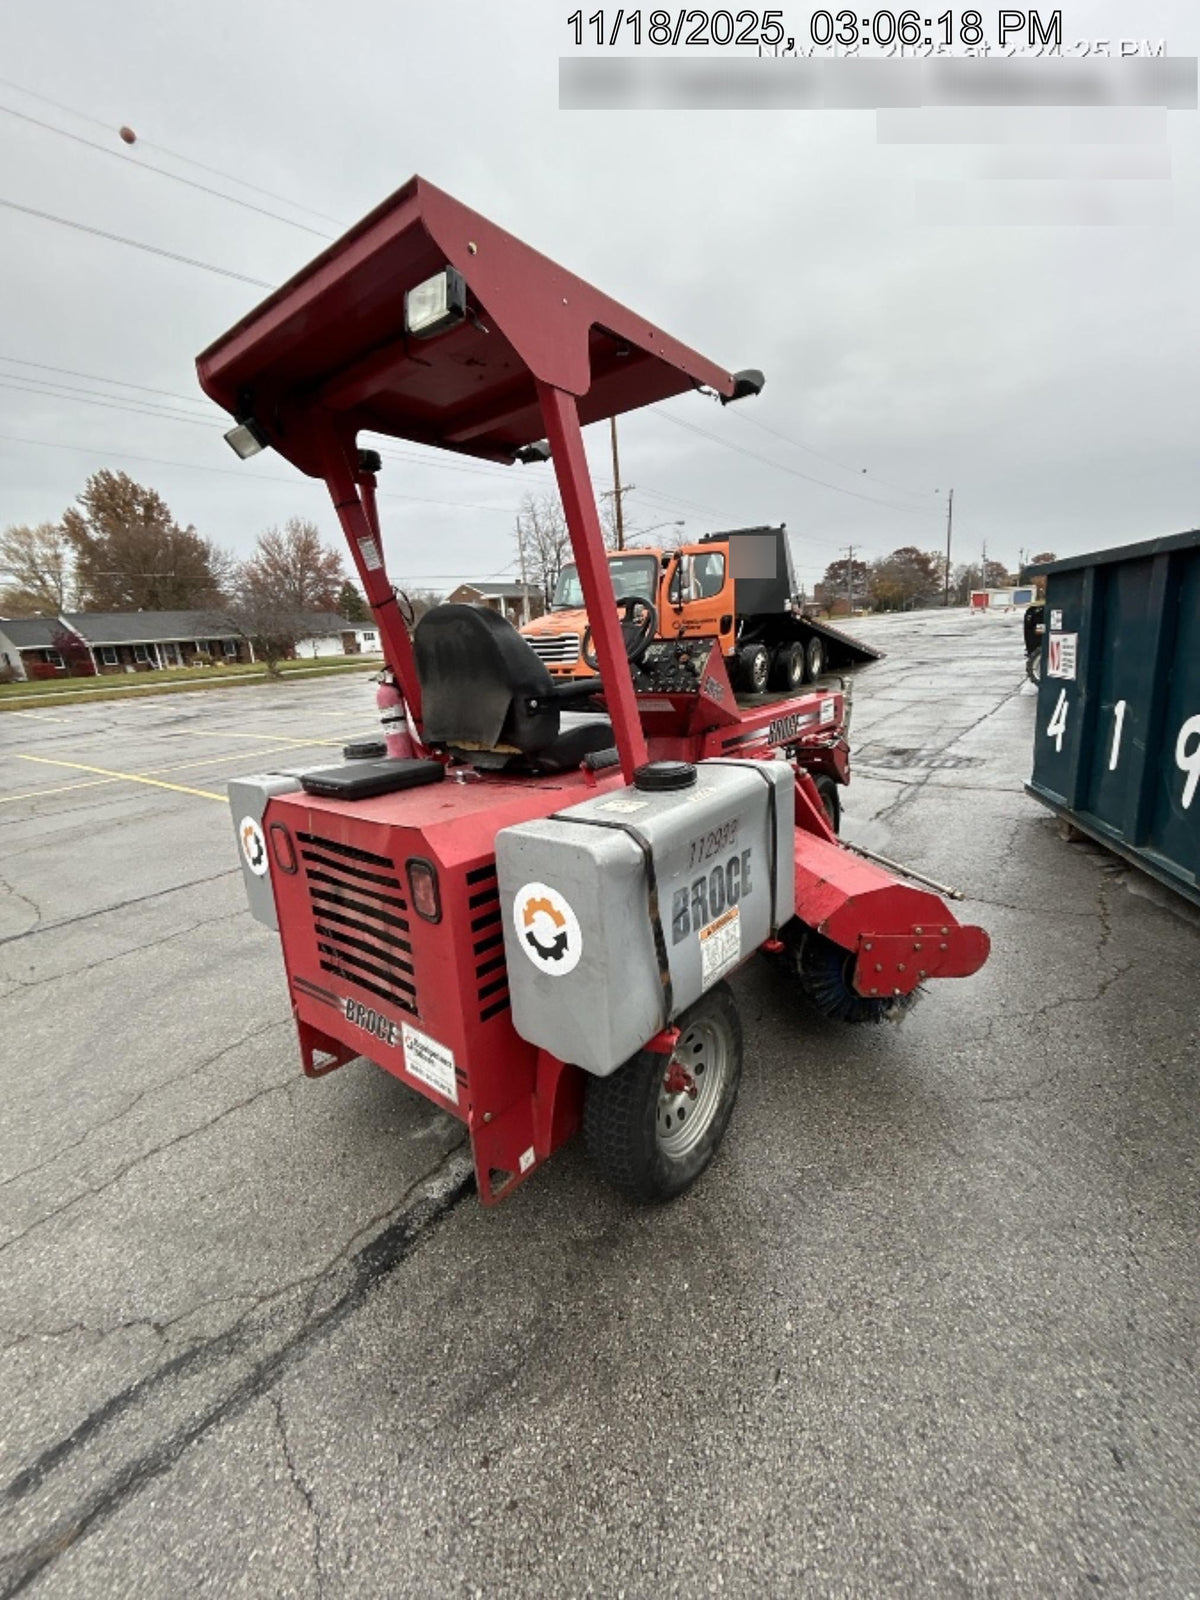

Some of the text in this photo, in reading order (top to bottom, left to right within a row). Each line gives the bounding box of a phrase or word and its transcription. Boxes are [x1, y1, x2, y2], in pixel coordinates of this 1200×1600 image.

[1046, 688, 1069, 752] 4
[671, 847, 753, 947] BROCE
[346, 997, 397, 1047] BROCE
